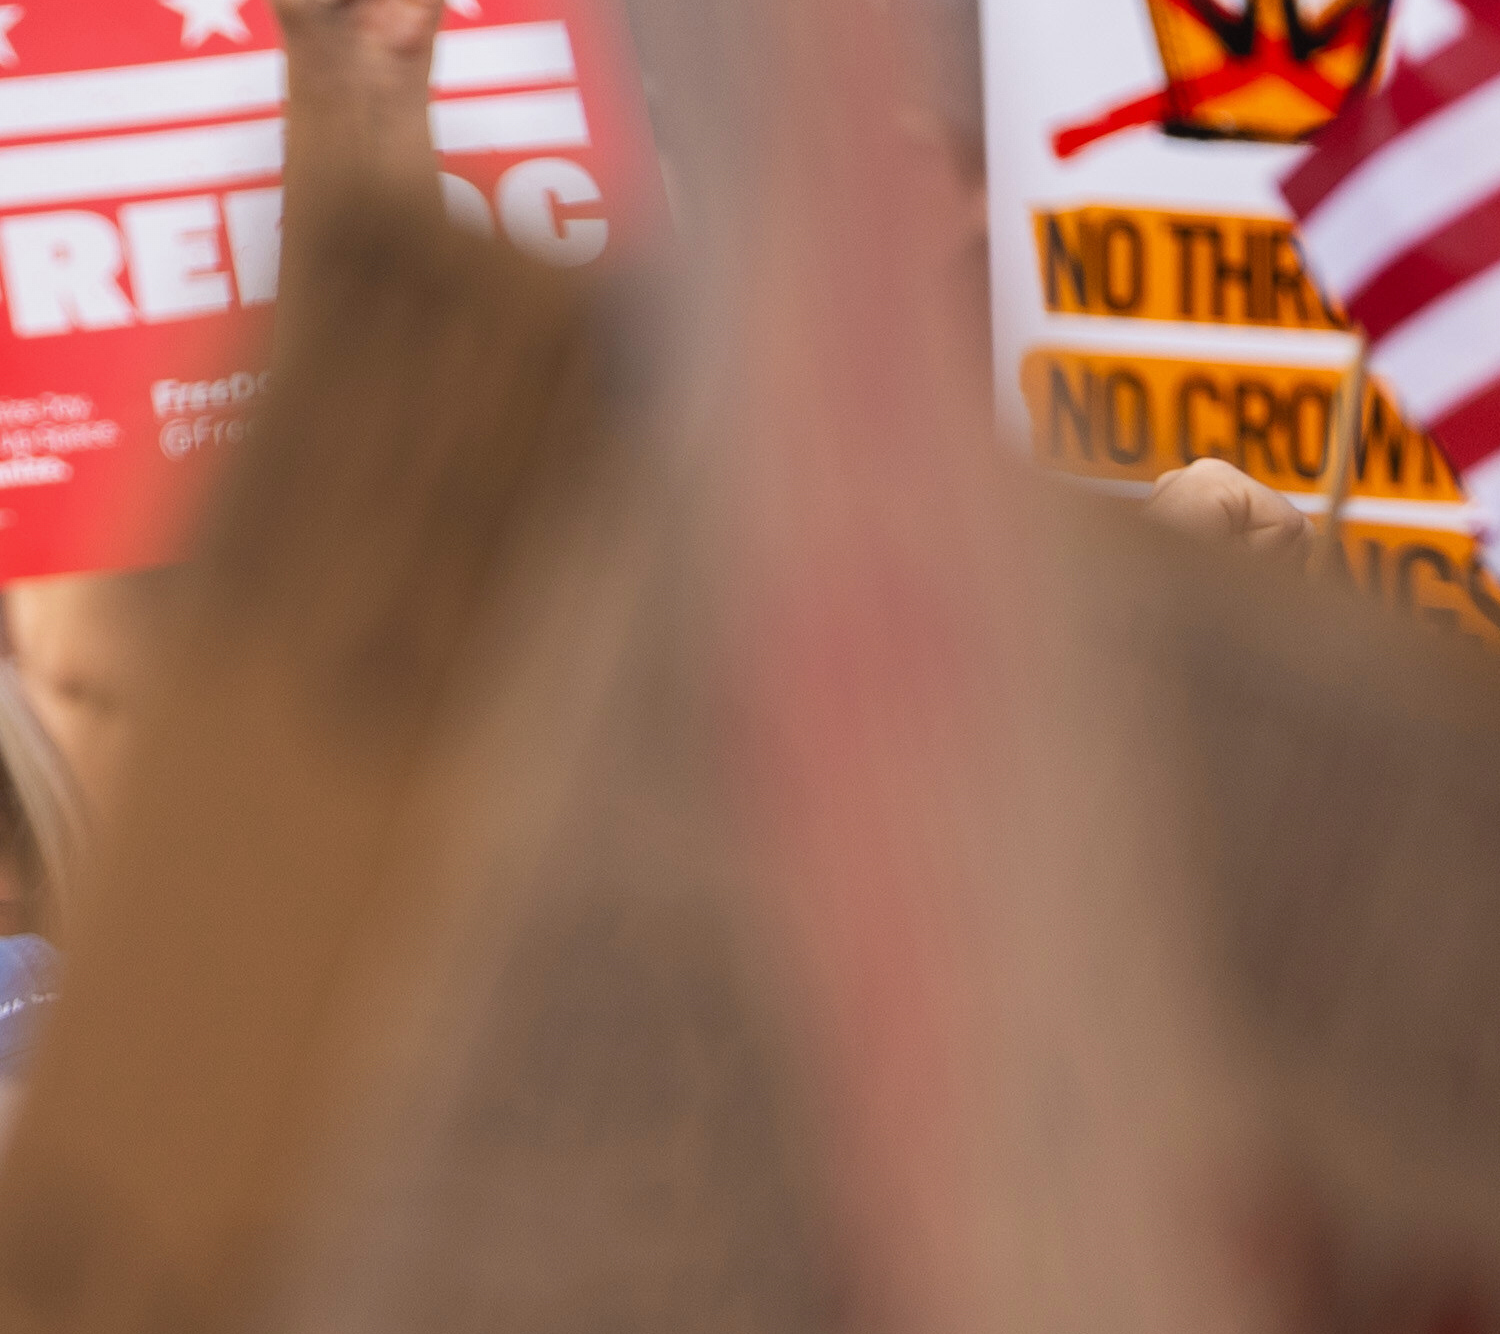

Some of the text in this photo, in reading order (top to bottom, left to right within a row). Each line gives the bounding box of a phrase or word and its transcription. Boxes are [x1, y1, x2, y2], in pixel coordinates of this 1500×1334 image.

[1045, 212, 1350, 331] NO THR
[1047, 357, 1149, 467] NO
